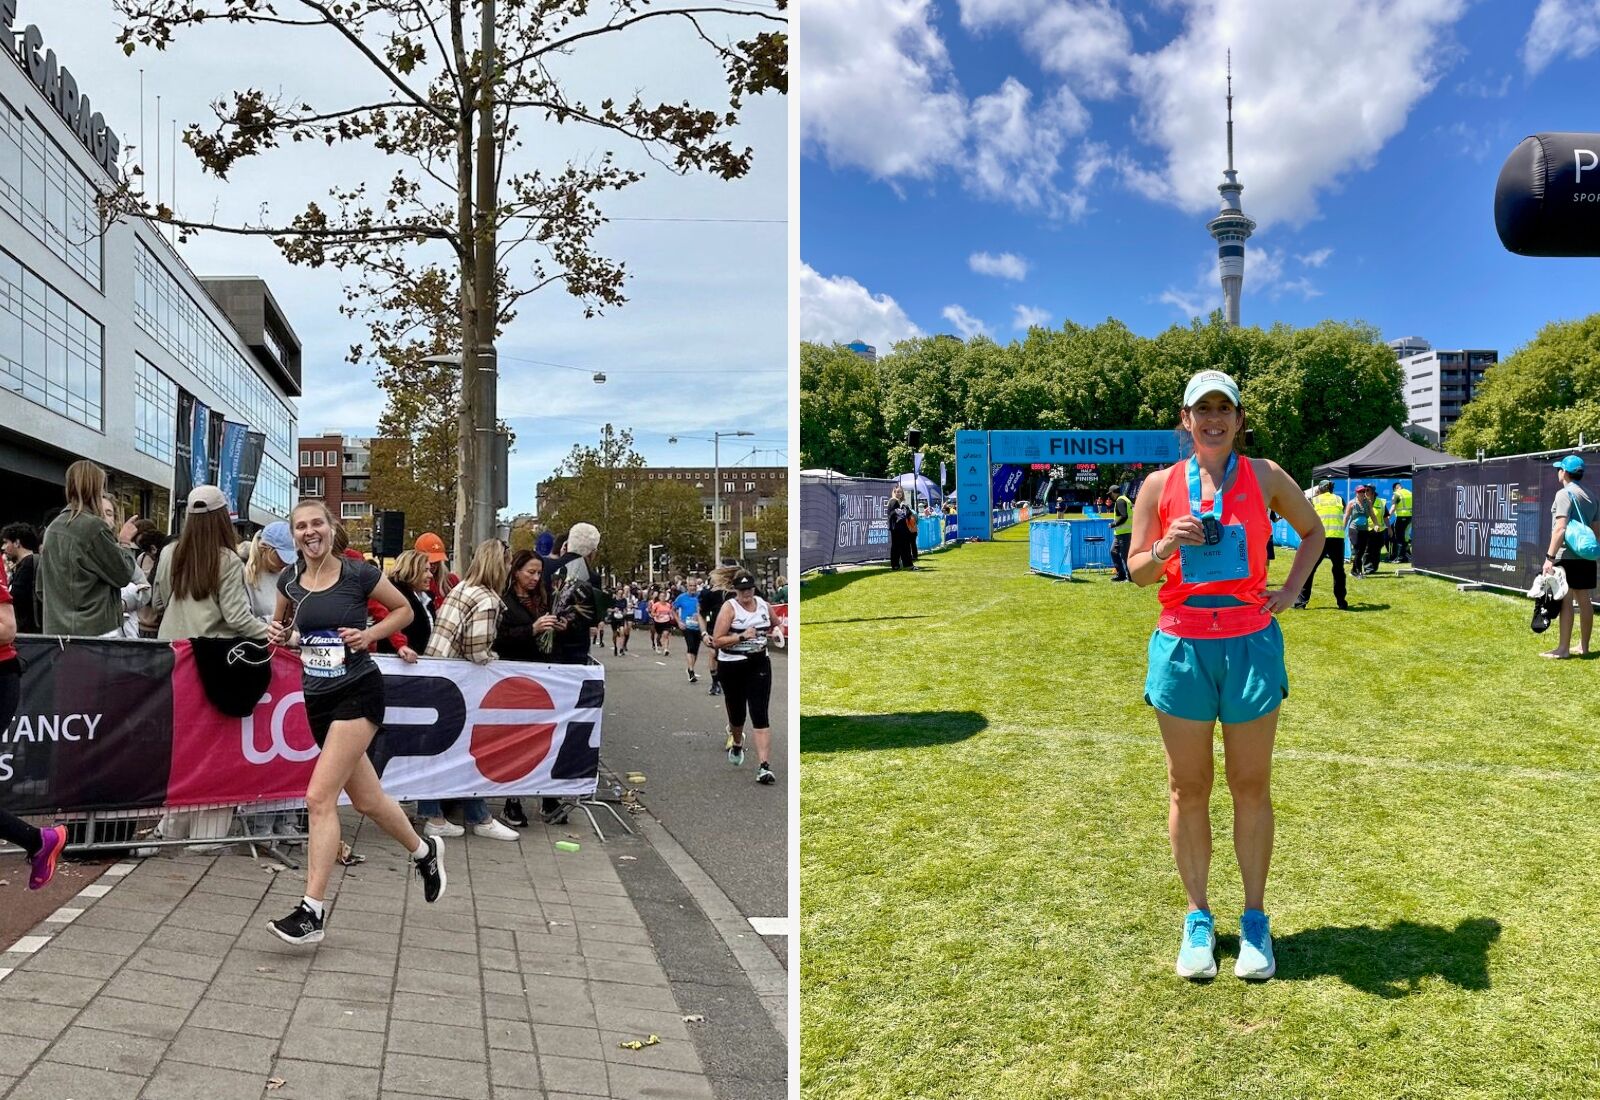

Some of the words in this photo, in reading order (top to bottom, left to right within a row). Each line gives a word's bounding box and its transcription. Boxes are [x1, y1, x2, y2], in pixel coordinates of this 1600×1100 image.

[24, 24, 120, 184] GARAGE
[1050, 438, 1124, 455] FINISH
[840, 494, 864, 520] RUN
[864, 495, 888, 520] THE
[1456, 485, 1485, 520] RUN
[1487, 483, 1519, 521] THE
[838, 521, 868, 547] CITY
[1456, 520, 1490, 557] CITY
[1490, 535, 1518, 549] AUCKLAND
[1489, 547, 1517, 561] MARATHON
